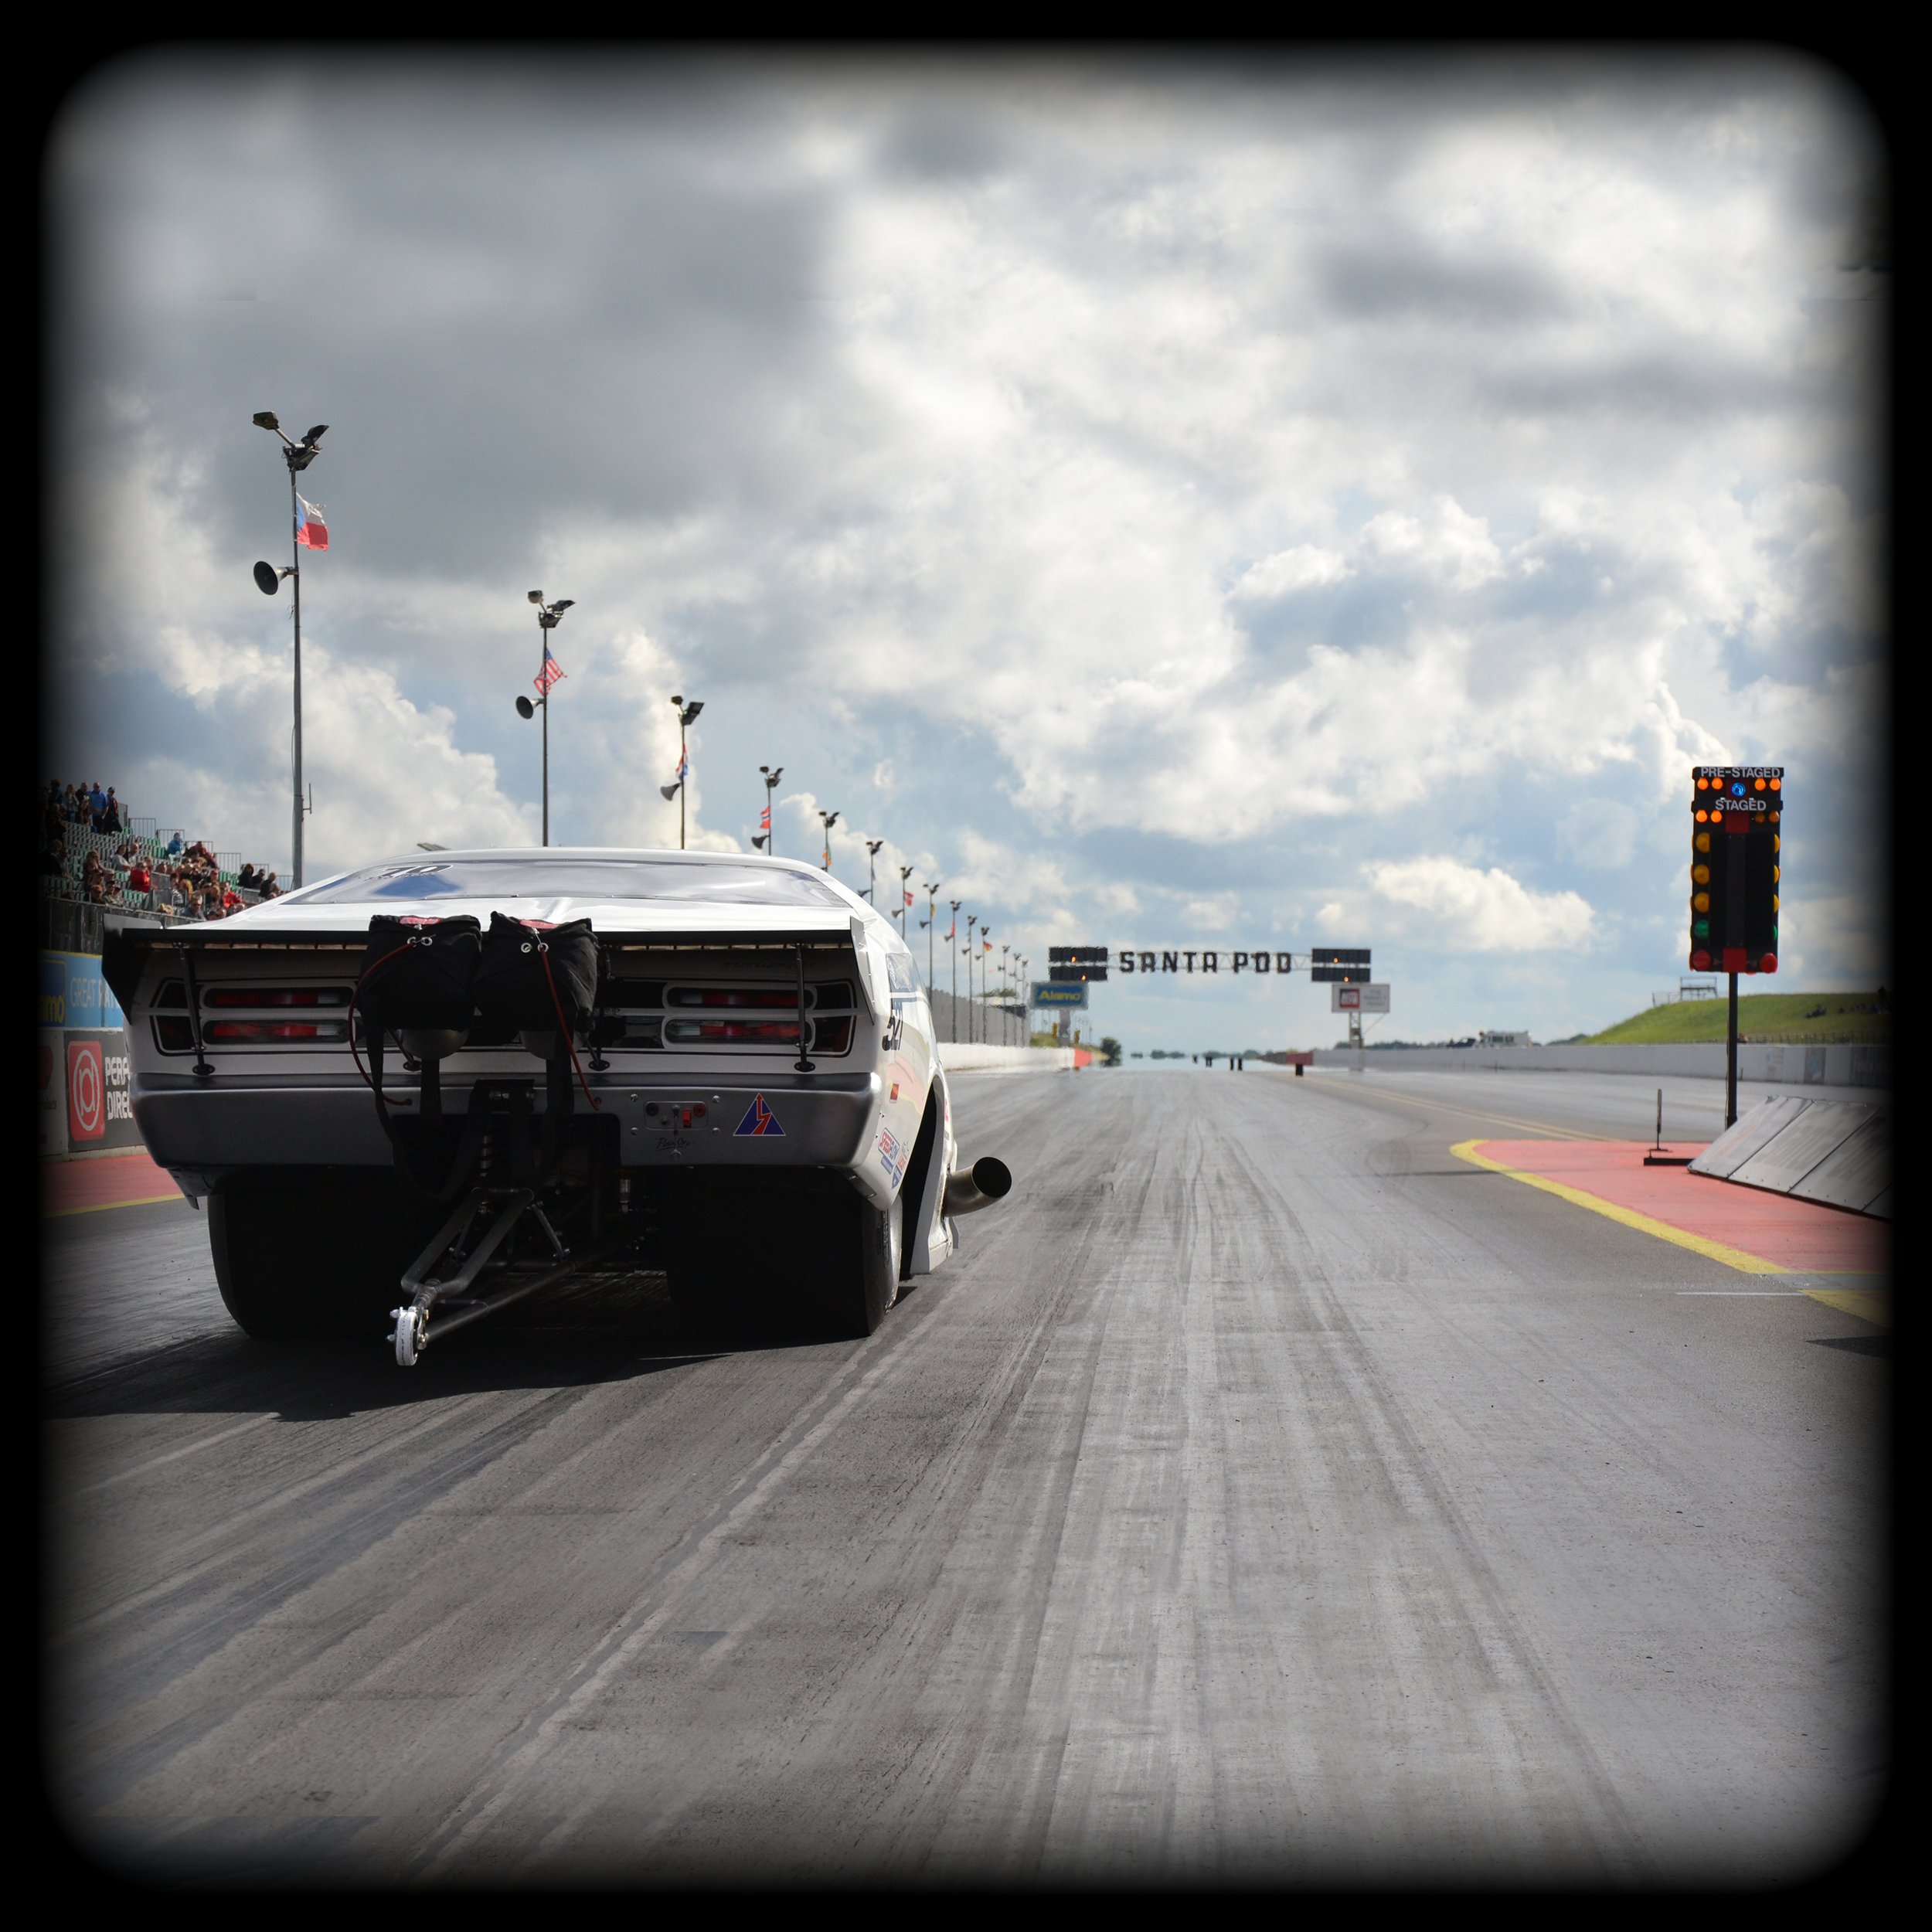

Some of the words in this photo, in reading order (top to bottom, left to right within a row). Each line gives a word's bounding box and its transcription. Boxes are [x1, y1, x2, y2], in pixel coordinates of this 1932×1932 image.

[1701, 767, 1781, 777] PRE-STAGED
[1716, 800, 1767, 811] STAGED
[1120, 951, 1217, 974] SANTA
[1234, 951, 1291, 974] POD
[70, 977, 95, 1008] GREAT
[1039, 991, 1081, 1001] Alamo
